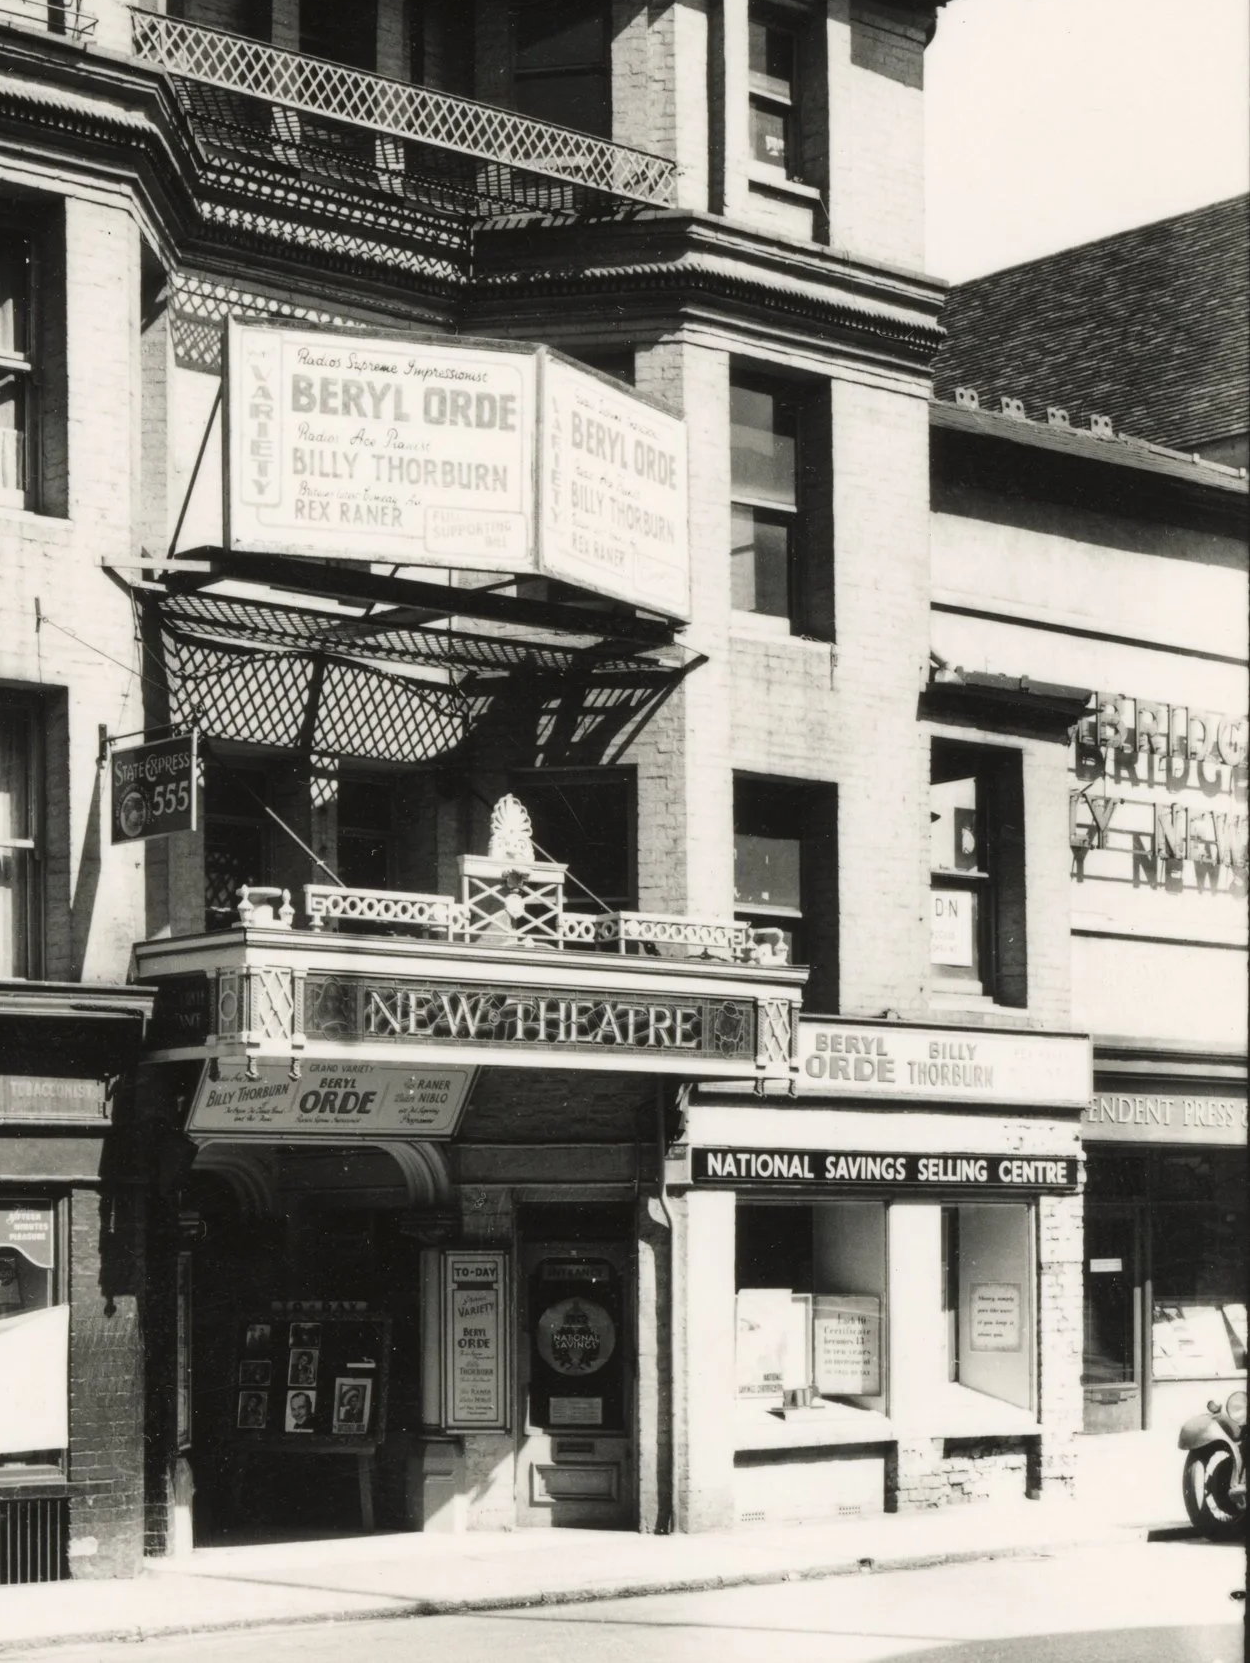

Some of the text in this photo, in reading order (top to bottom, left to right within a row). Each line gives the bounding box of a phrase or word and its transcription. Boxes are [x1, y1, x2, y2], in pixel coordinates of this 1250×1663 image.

[345, 352, 398, 377] Supreme
[290, 373, 411, 423] BERYL
[422, 385, 517, 431] ORDE
[248, 364, 274, 496] VARIETY
[349, 427, 376, 447] Ace
[570, 409, 628, 471] BERYL
[633, 439, 677, 491] ORDE
[291, 446, 509, 494] BILLY THORBURN
[294, 498, 404, 528] REX RANER
[571, 479, 606, 517] BILLY
[609, 495, 675, 545] THORBURN
[114, 753, 191, 787] STATE EXPRESS
[152, 780, 190, 816] 555
[369, 990, 698, 1049] NEW THEATRE
[814, 1032, 888, 1057] BERYL
[928, 1040, 978, 1062] BILLY
[309, 1063, 376, 1074] GRAND VARIETY
[805, 1055, 897, 1084] ORDE
[906, 1059, 994, 1090] THORBURN
[206, 1082, 291, 1108] BILLY THORBURN
[319, 1077, 357, 1089] BERYL
[417, 1079, 451, 1090] RANER
[299, 1089, 378, 1115] ORDE
[417, 1092, 449, 1104] NIBLO
[1182, 1097, 1235, 1128] PRESS
[707, 1151, 1068, 1185] NATIONAL SAVINGS SELLING CENTRE
[453, 1267, 497, 1278] TO-DAY
[457, 1301, 495, 1318] VARIETY
[457, 1338, 491, 1349] ORDE
[553, 1333, 601, 1342] NATIONAL
[555, 1341, 597, 1350] SAVINGS
